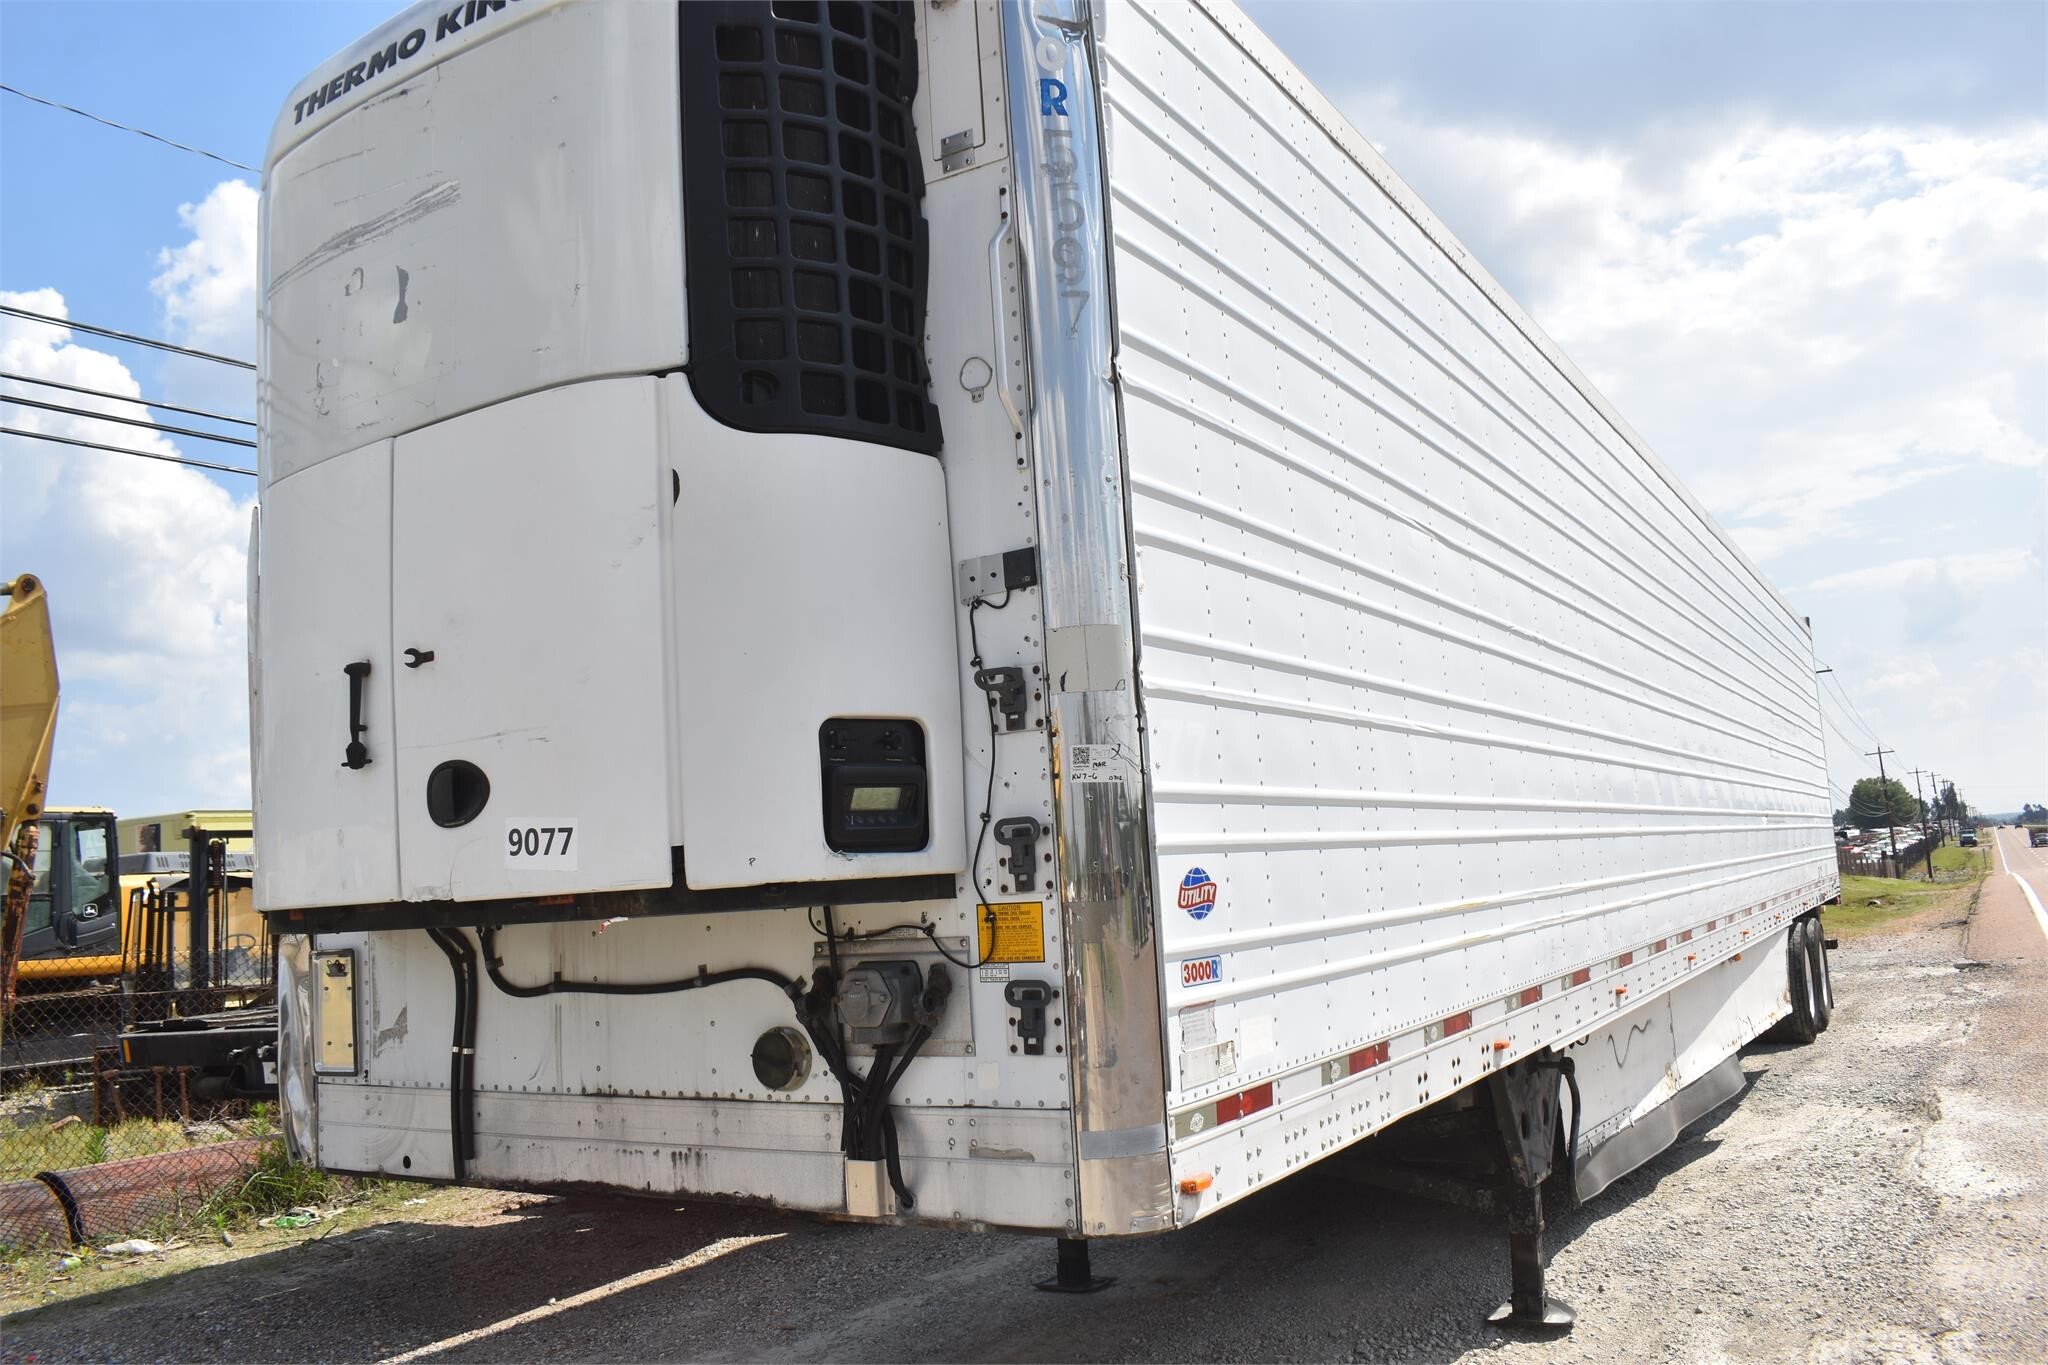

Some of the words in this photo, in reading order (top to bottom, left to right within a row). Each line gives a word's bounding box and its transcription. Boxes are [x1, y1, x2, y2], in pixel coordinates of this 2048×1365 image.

[294, 28, 426, 125] THERMO
[435, 0, 520, 42] KIN
[508, 827, 574, 856] 9077
[1180, 885, 1216, 906] UTILITY
[1183, 959, 1219, 983] 3000R
